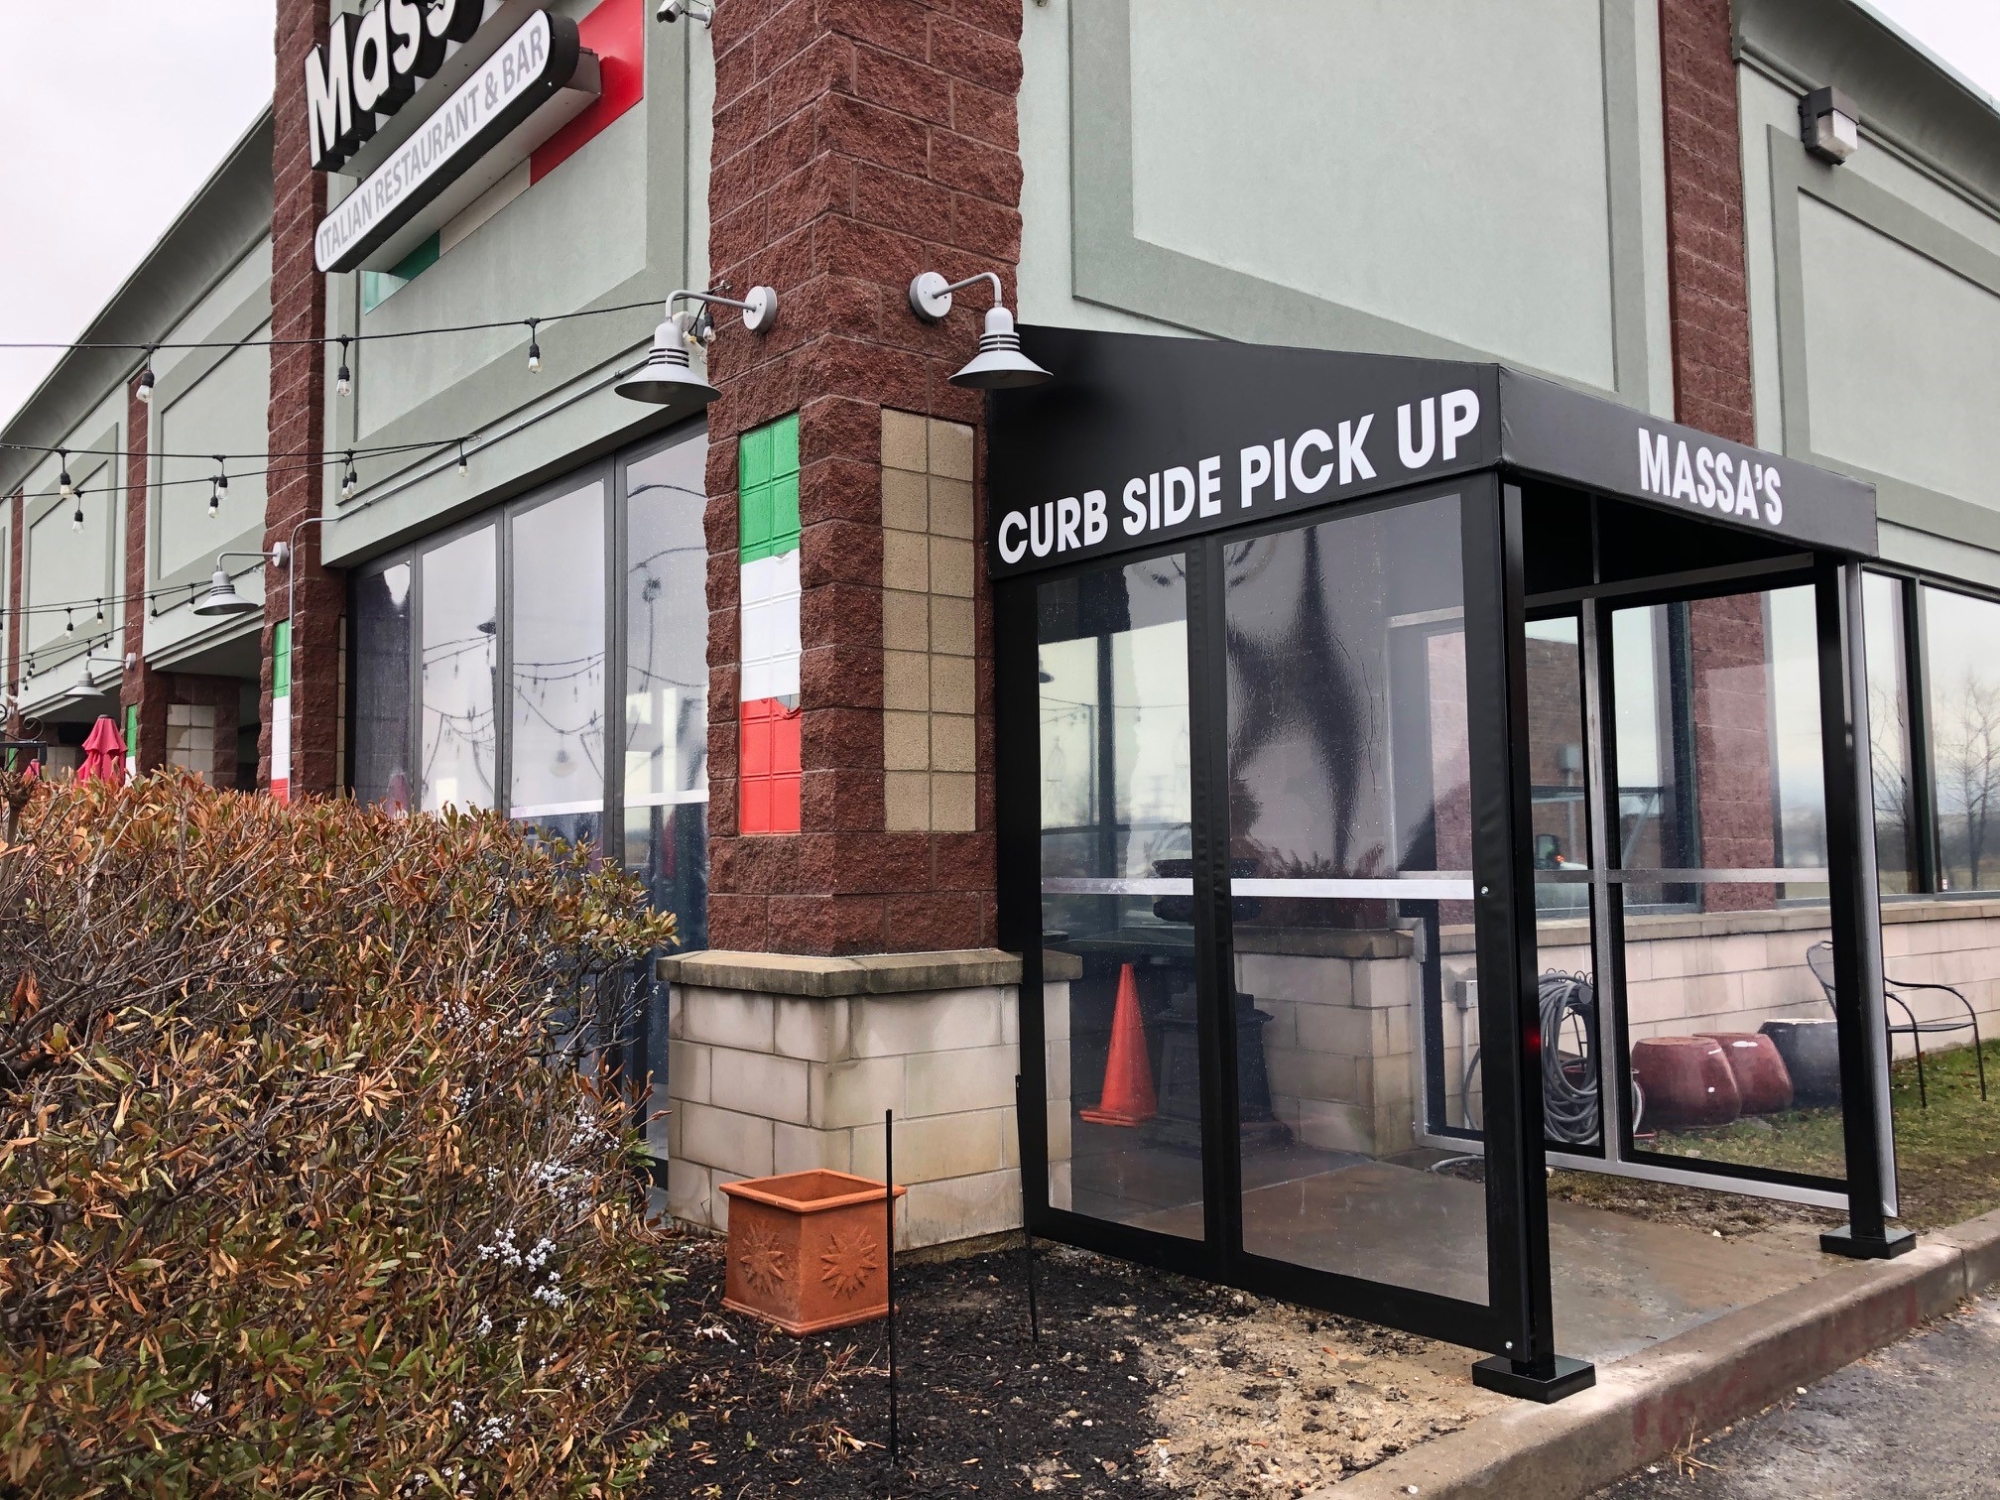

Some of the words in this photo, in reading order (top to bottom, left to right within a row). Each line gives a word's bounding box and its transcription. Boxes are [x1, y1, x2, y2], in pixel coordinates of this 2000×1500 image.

[319, 188, 373, 263] ITALIAN
[374, 84, 480, 213] RESTAURANT
[484, 71, 499, 110] &
[502, 25, 544, 95] BAR
[998, 489, 1108, 564] CURB
[1122, 455, 1222, 536] SIDE
[1240, 413, 1377, 509] PICK
[1397, 389, 1480, 469] UP
[1638, 427, 1784, 526] MASSA'S
